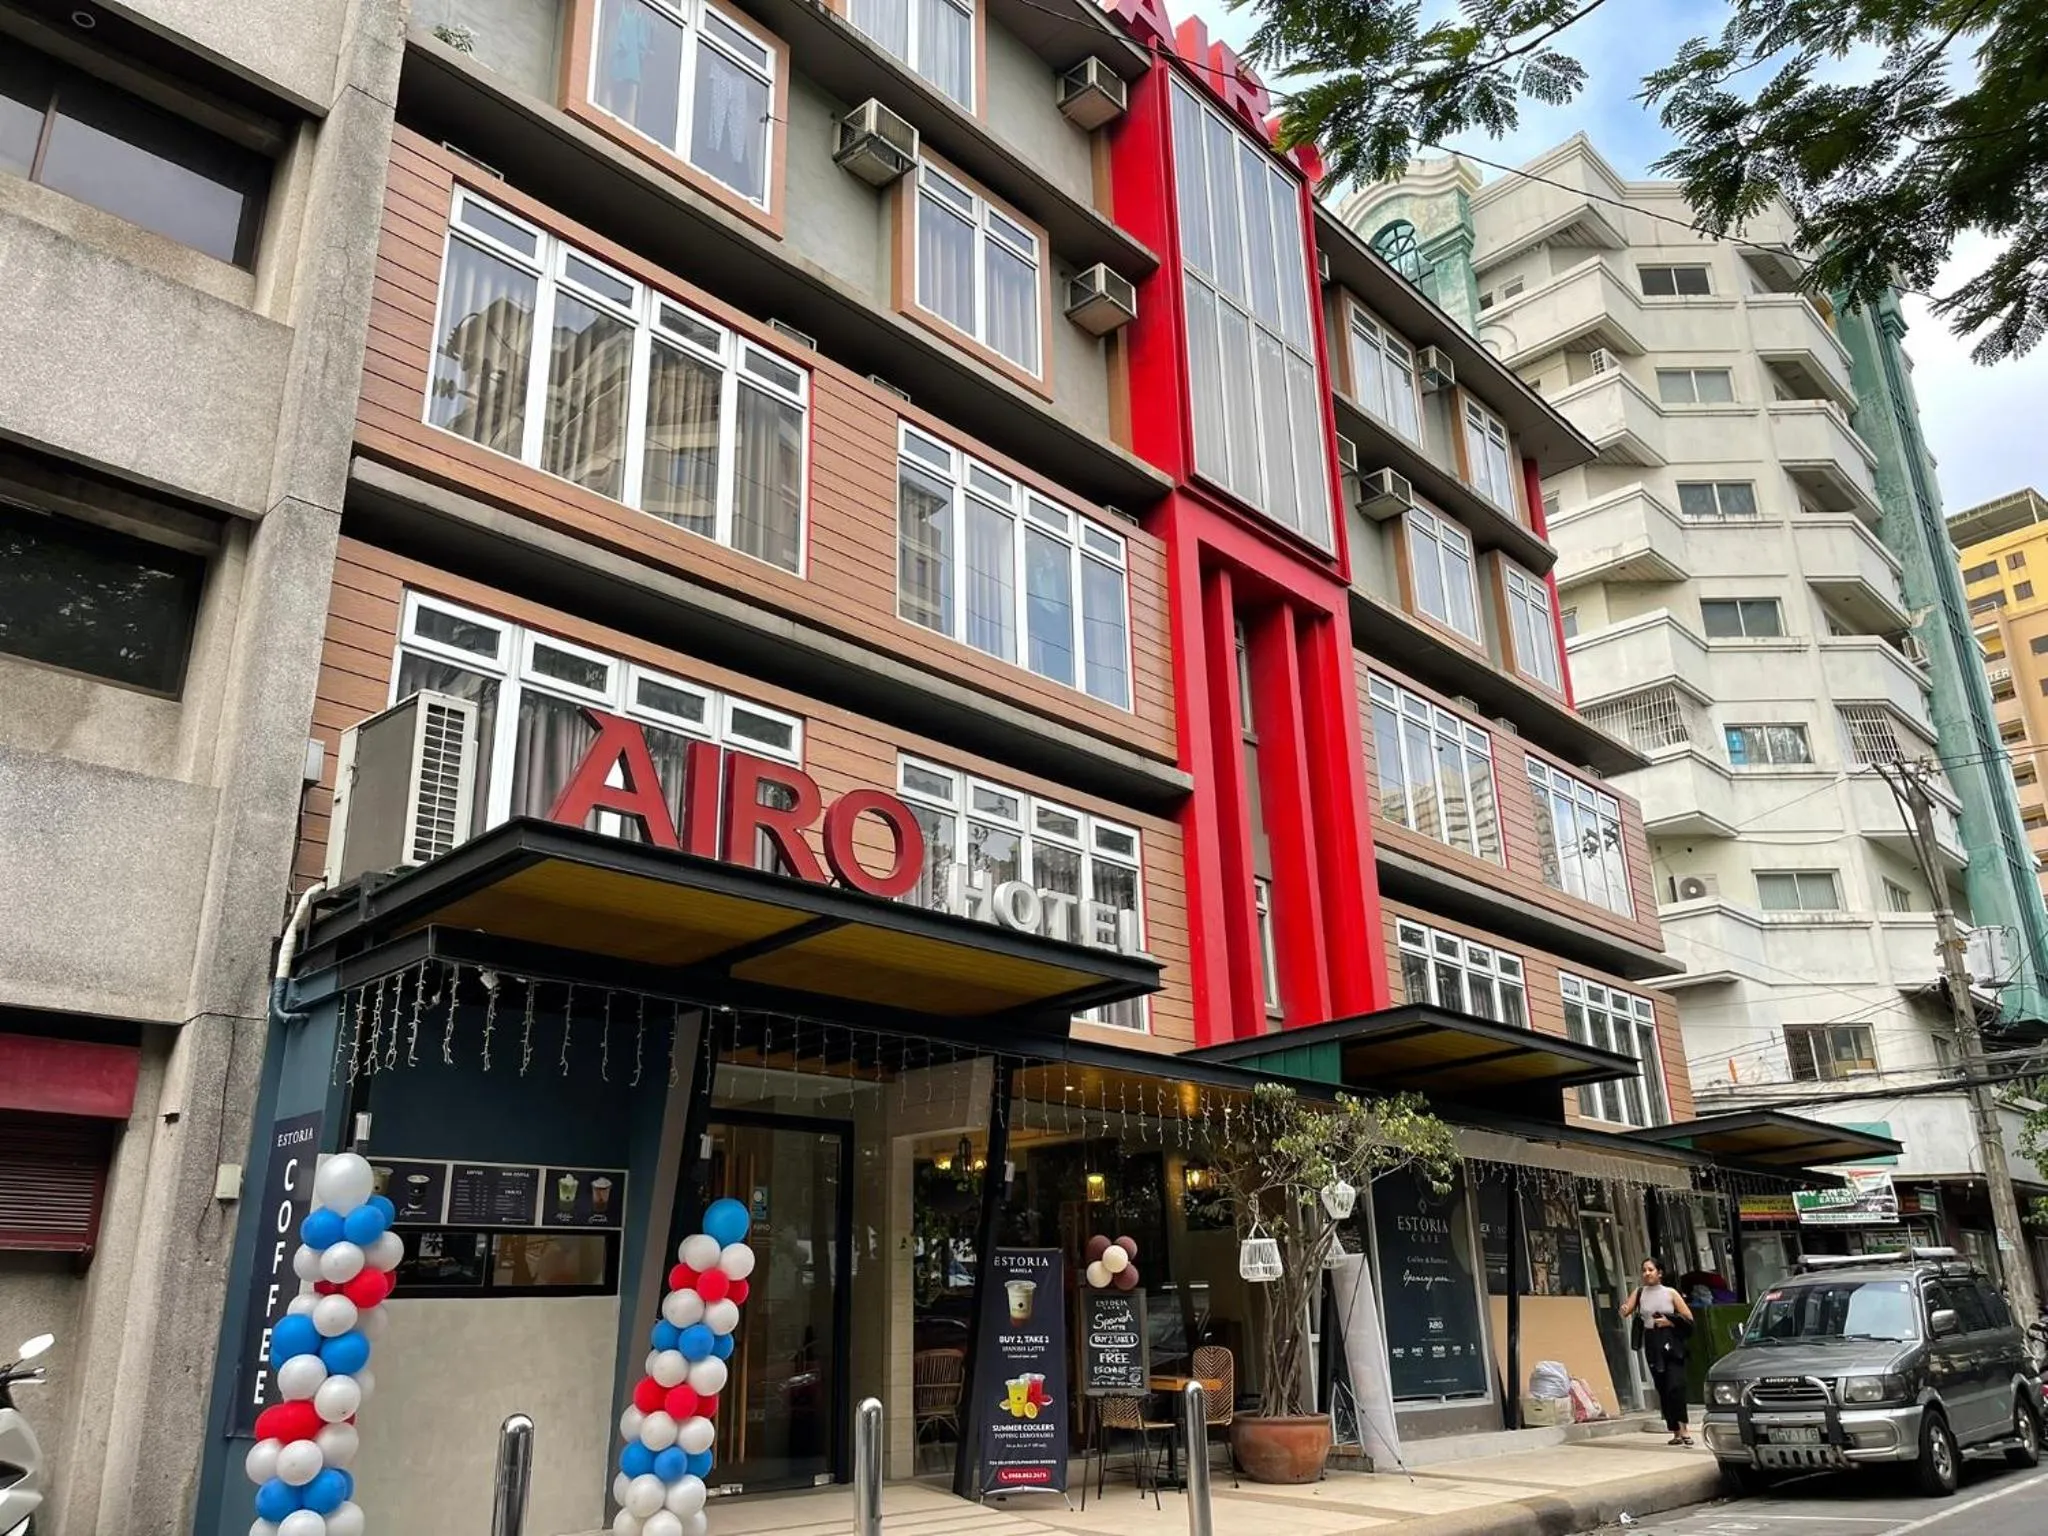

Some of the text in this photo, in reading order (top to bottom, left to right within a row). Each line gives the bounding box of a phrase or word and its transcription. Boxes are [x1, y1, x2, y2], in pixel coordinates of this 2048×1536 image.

[549, 706, 924, 897] AIRO
[949, 863, 1154, 959] HOTEL
[277, 1127, 314, 1147] ESTORIA
[1397, 1216, 1449, 1234] ESTORIA
[993, 1256, 1049, 1267] ESTORIA
[253, 1158, 297, 1404] COFFEE
[999, 1335, 1015, 1344] BUY
[1024, 1335, 1044, 1344] TAKE
[1099, 1352, 1130, 1364] FREE
[992, 1423, 1055, 1432] SUMMER COOLERS
